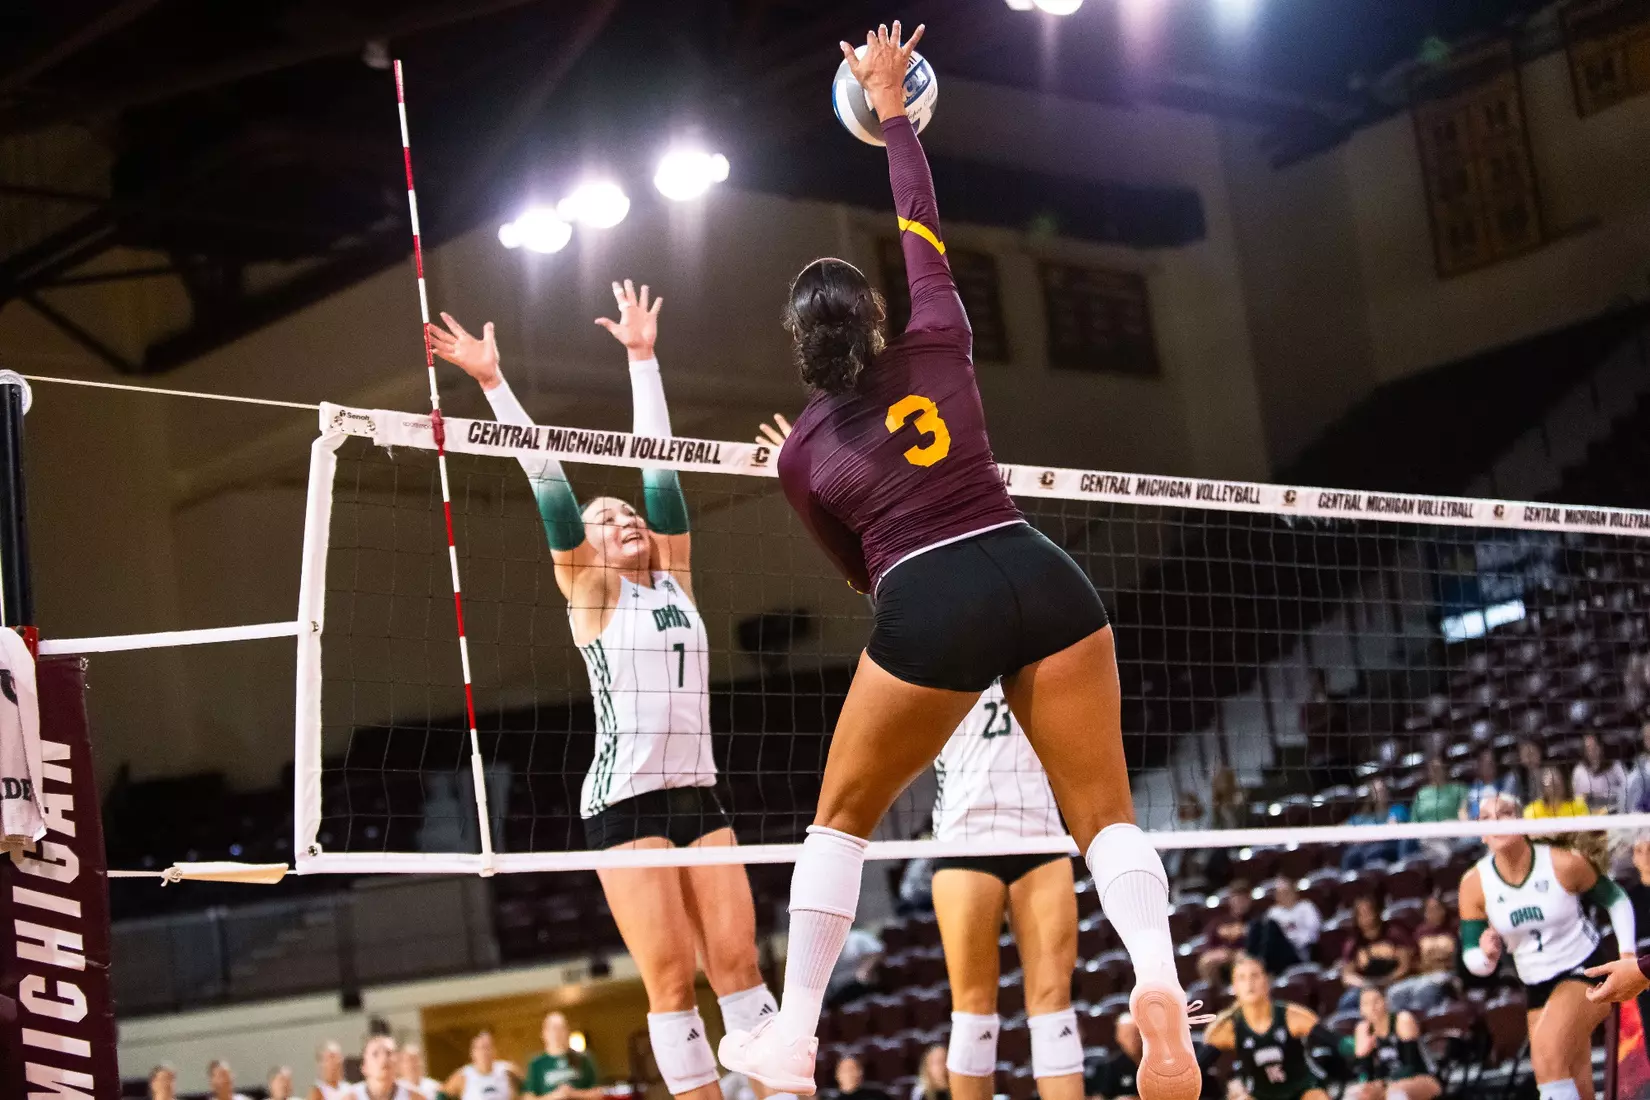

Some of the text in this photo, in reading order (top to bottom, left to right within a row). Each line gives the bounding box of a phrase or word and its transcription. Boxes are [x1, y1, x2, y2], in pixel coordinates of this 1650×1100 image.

[347, 412, 370, 421] Senoh
[885, 394, 951, 467] 3
[467, 421, 721, 464] CENTRAL MICHIGAN VOLLEYBALL
[1080, 473, 1261, 504] CENTRAL MICHIGAN VOLLEYBALL
[1318, 492, 1474, 519] CENTRAL MICHIGAN VOLLEYBALL
[1524, 506, 1561, 524] CENTRAL
[1564, 509, 1608, 527] MICHIGAN
[652, 604, 691, 632] OHIO
[982, 699, 1011, 738] 23
[1510, 906, 1545, 927] OHIO
